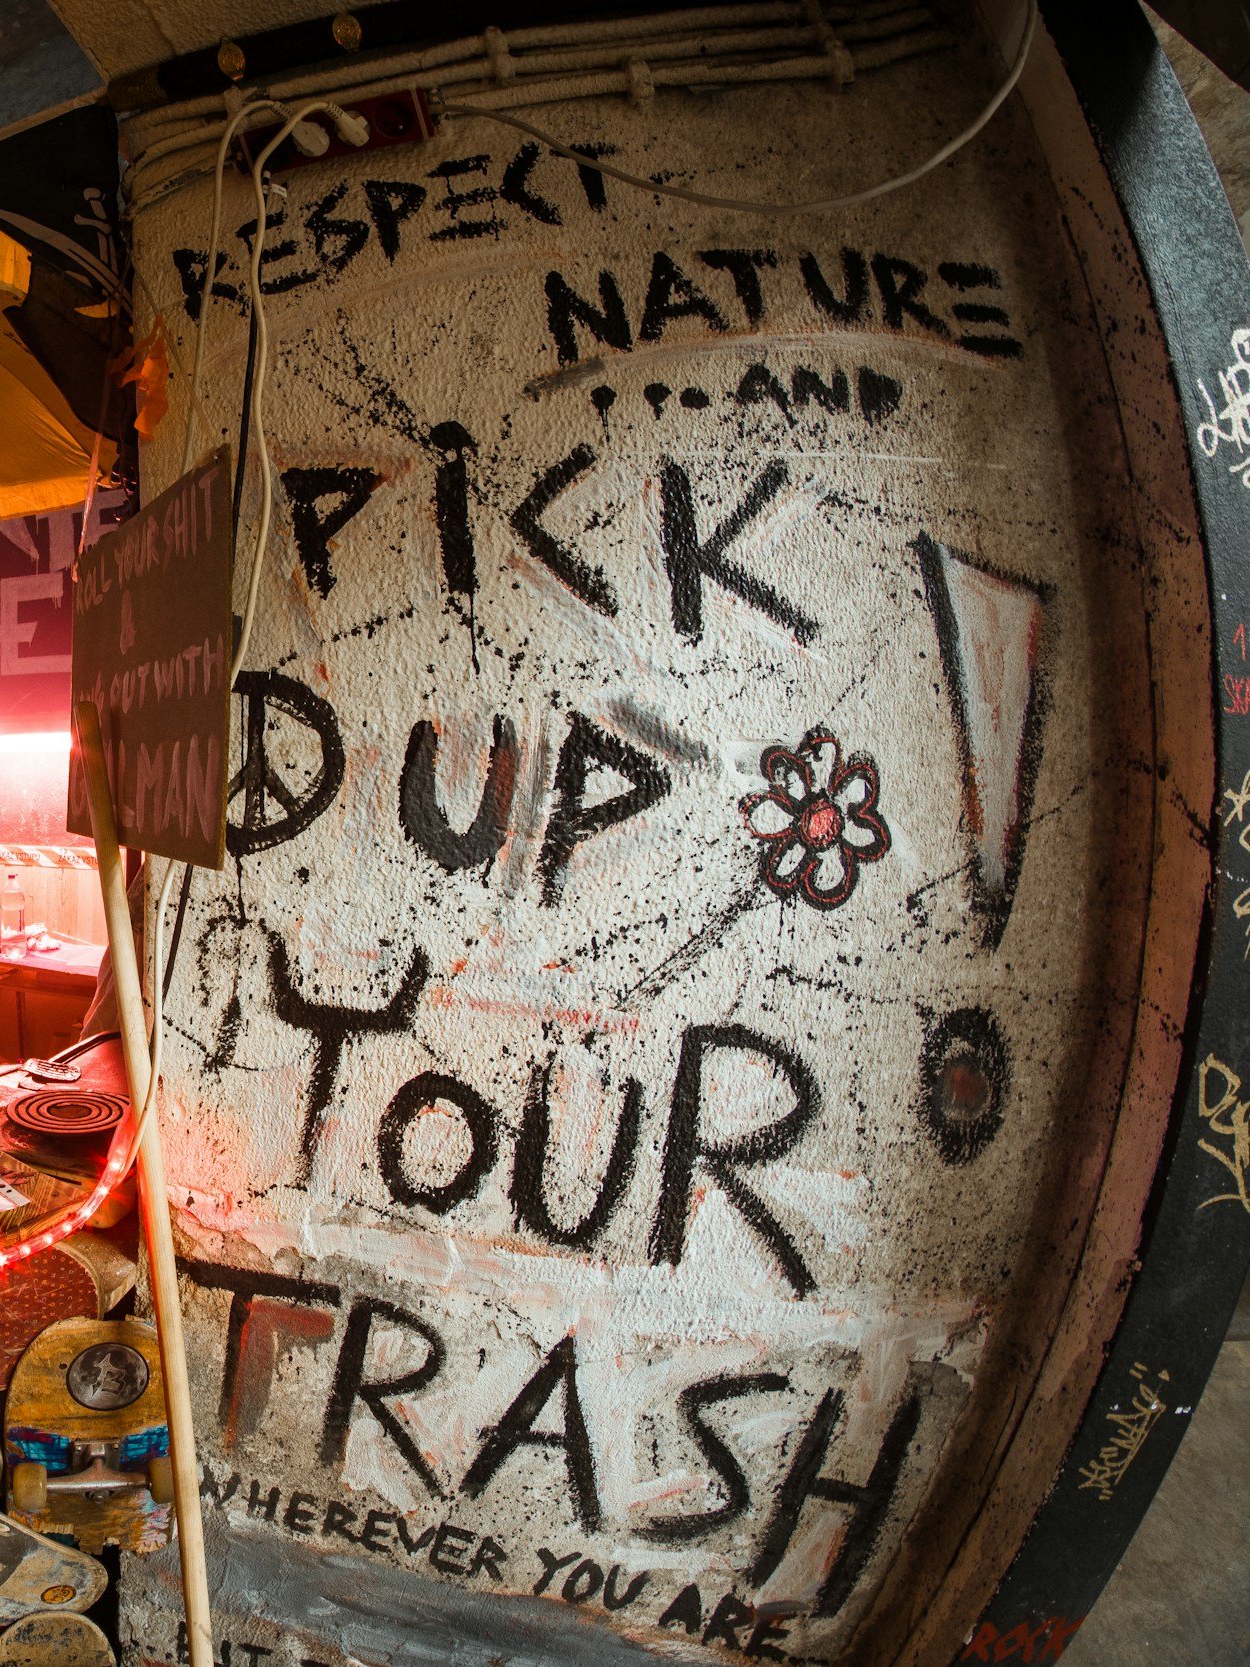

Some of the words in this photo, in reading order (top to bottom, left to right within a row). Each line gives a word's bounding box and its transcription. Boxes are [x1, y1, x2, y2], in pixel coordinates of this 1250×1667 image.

[174, 140, 618, 320] RESPECT
[545, 247, 1023, 366] NATURE
[114, 515, 160, 590] YOUR
[162, 466, 220, 573] SHIT
[280, 420, 820, 648] PICK
[110, 661, 150, 714] OUT
[153, 632, 224, 703] WITH
[398, 711, 673, 907] UP
[267, 920, 820, 1299] YOUR
[177, 1256, 922, 1615] TRASH
[202, 1464, 503, 1584] WHEREVER
[534, 1547, 654, 1611] YOU
[658, 1588, 799, 1661] ARE
